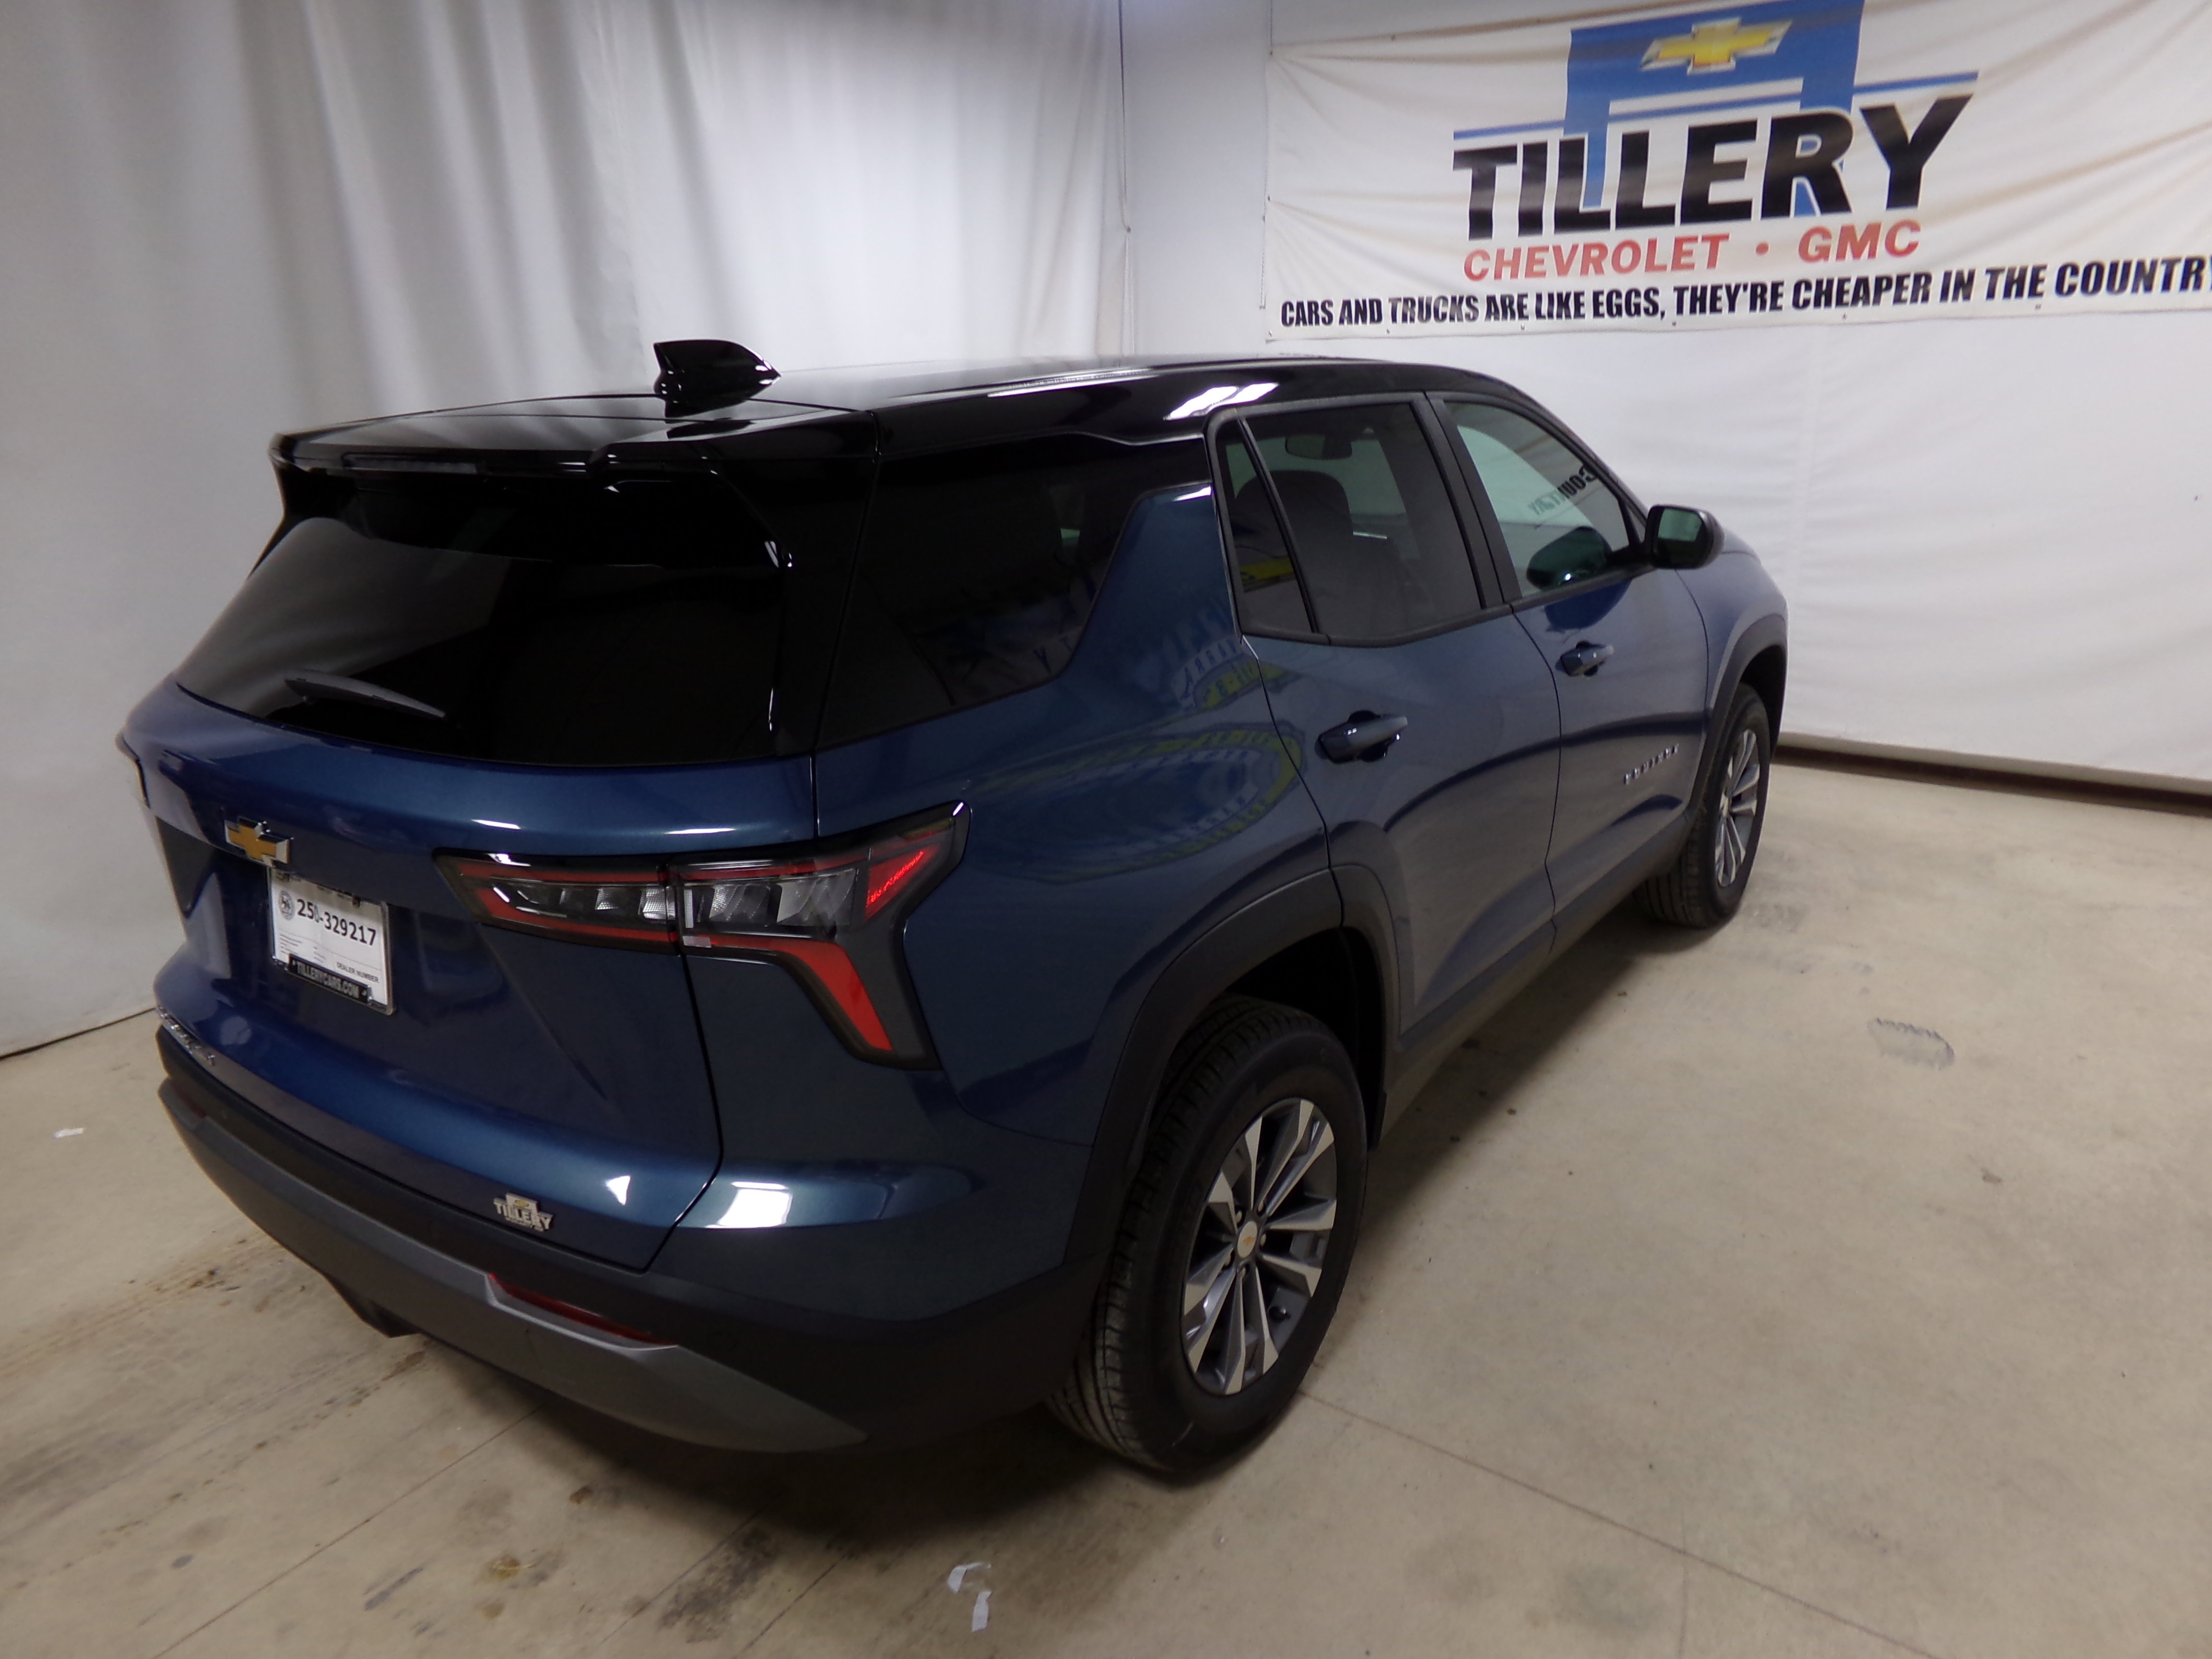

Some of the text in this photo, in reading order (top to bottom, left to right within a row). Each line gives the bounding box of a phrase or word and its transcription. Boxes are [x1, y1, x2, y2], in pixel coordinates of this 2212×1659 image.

[1453, 94, 1973, 240] TILLERY
[1464, 219, 1922, 282] CHEVROLET GMC
[1281, 254, 2212, 327] CARS AND TRUCKS ARE LIKE EGGS, THEY'RE CHEAPER IN THE COUNTR
